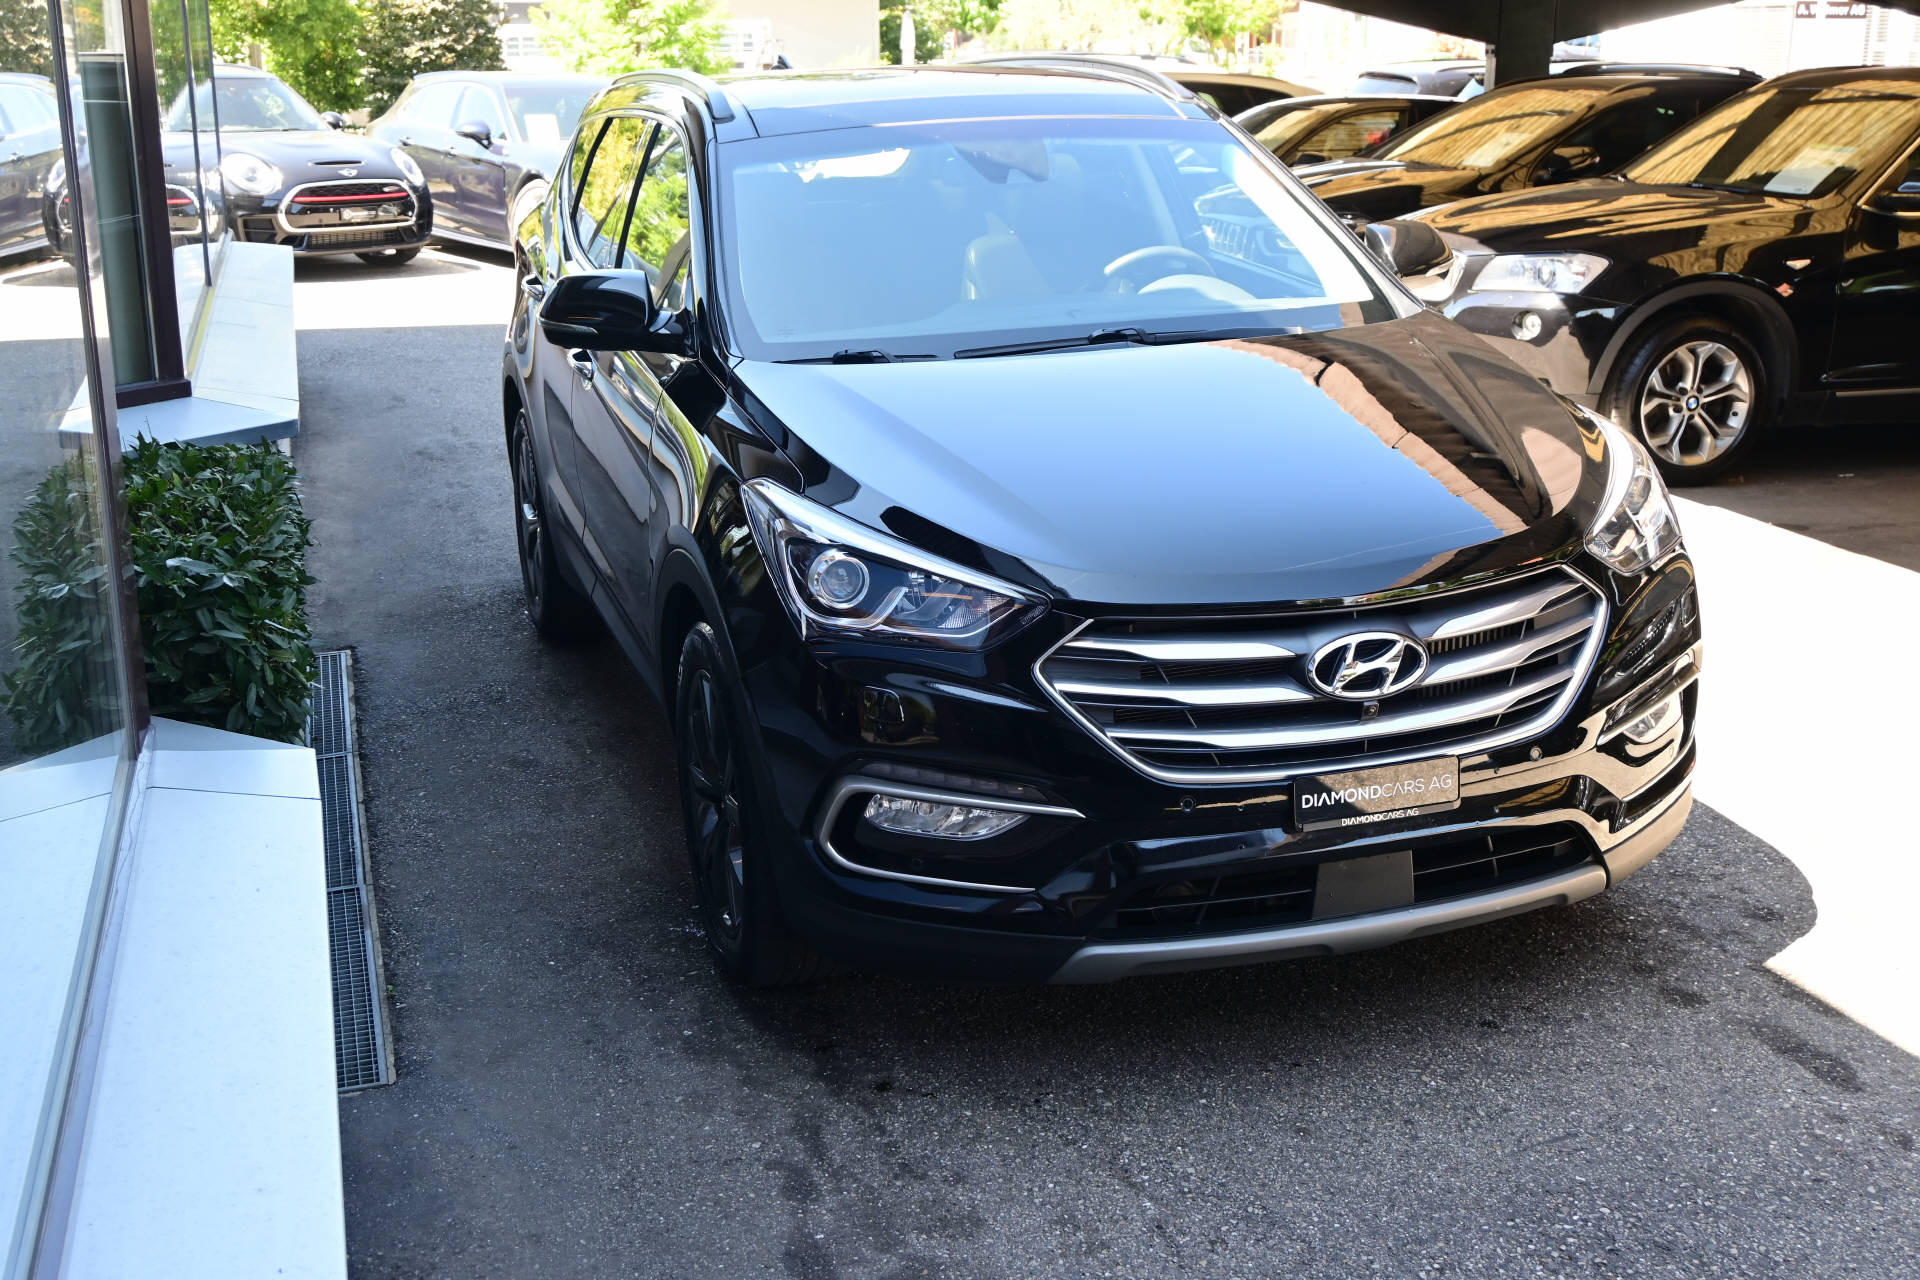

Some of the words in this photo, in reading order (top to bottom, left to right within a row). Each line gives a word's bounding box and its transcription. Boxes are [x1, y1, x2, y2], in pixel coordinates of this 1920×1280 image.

[1850, 4, 1866, 15] AG
[1301, 778, 1425, 809] DIAMONDCARS
[1428, 774, 1452, 791] AG
[1341, 809, 1405, 827] DIAMONDCARS
[1405, 807, 1420, 818] AG
